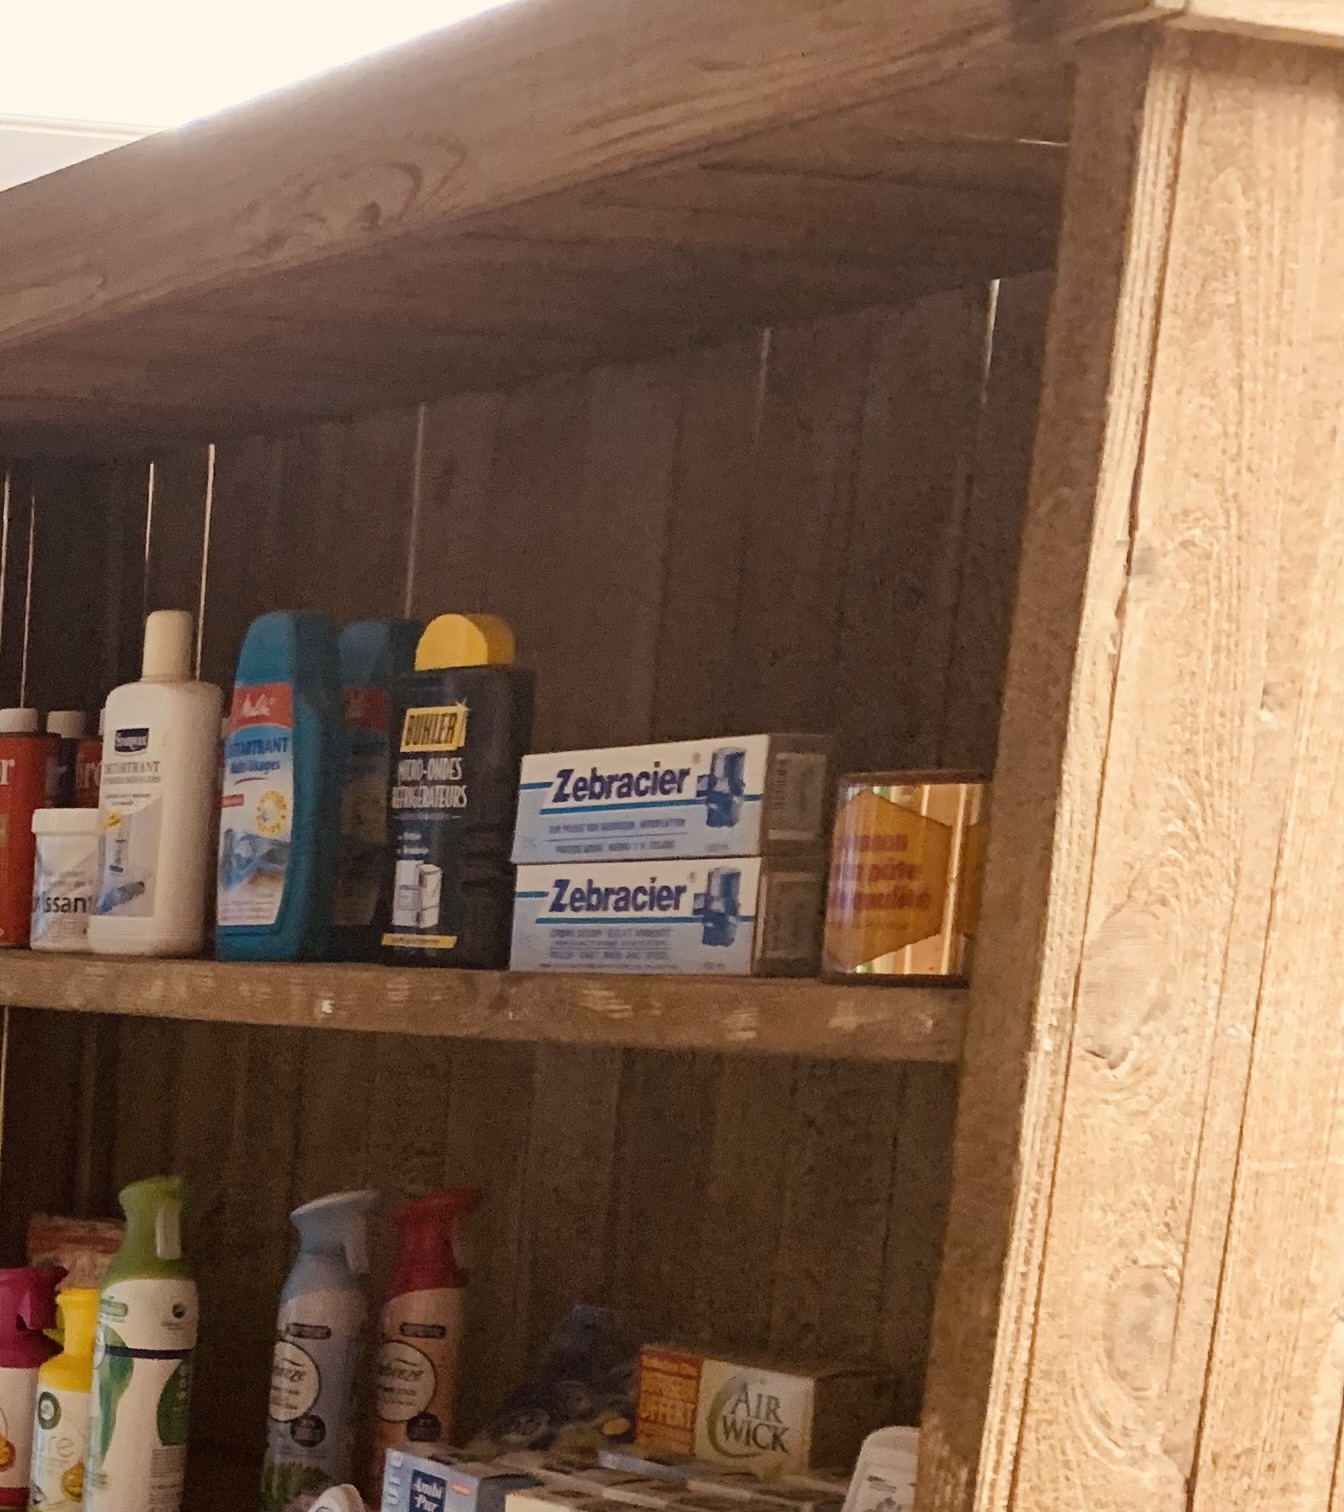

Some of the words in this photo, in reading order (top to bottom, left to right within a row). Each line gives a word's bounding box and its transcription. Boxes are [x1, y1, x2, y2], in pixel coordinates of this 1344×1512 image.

[551, 761, 691, 803] Zebracier
[548, 877, 688, 913] Zebracier
[730, 1380, 783, 1424] AIR
[722, 1413, 790, 1454] WICK
[413, 1476, 443, 1499] Ambi
[413, 1494, 440, 1512] Pur
